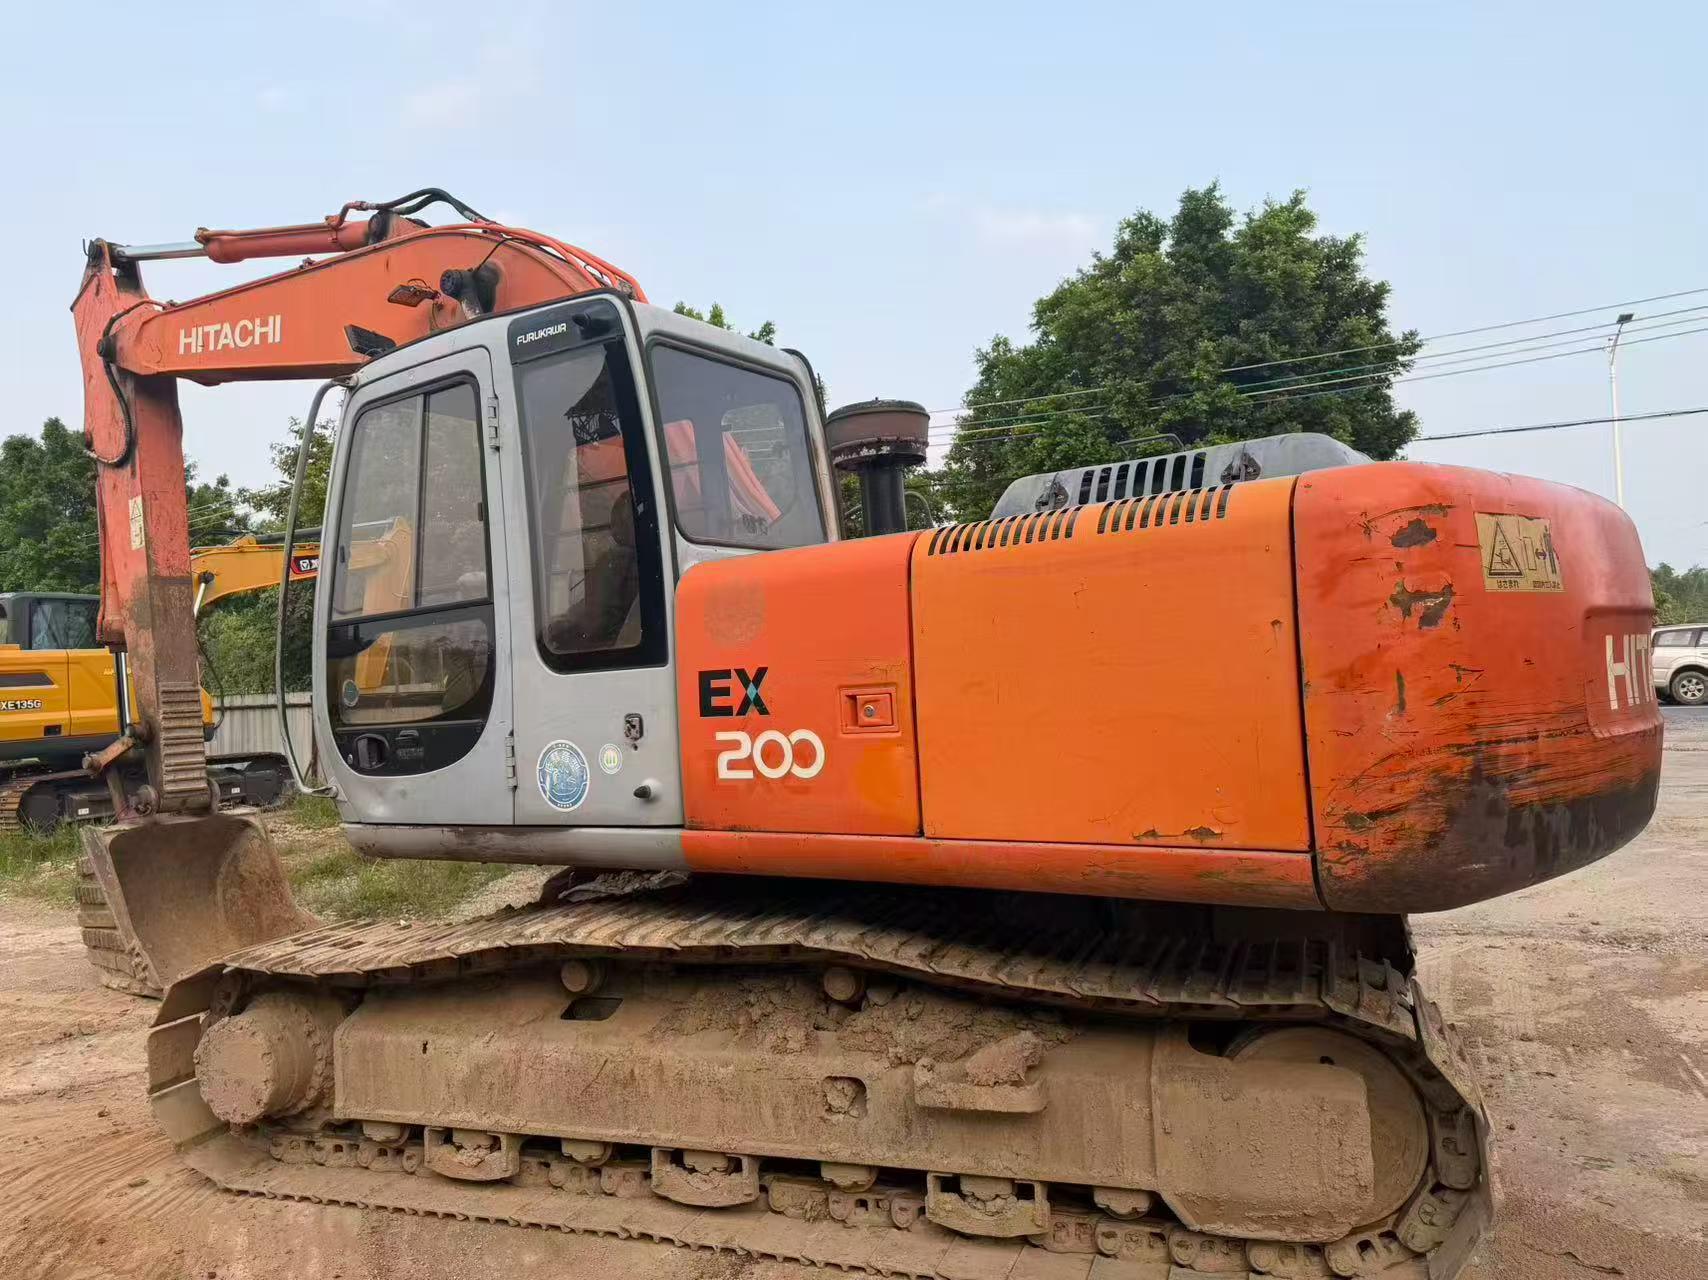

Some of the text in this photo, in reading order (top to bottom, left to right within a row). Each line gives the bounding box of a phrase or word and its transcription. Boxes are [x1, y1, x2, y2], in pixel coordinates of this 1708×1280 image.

[179, 314, 281, 354] HITACHI
[516, 323, 567, 345] FURUKAWA
[0, 699, 42, 710] XE135G
[698, 667, 770, 718] EX
[715, 729, 825, 779] 200
